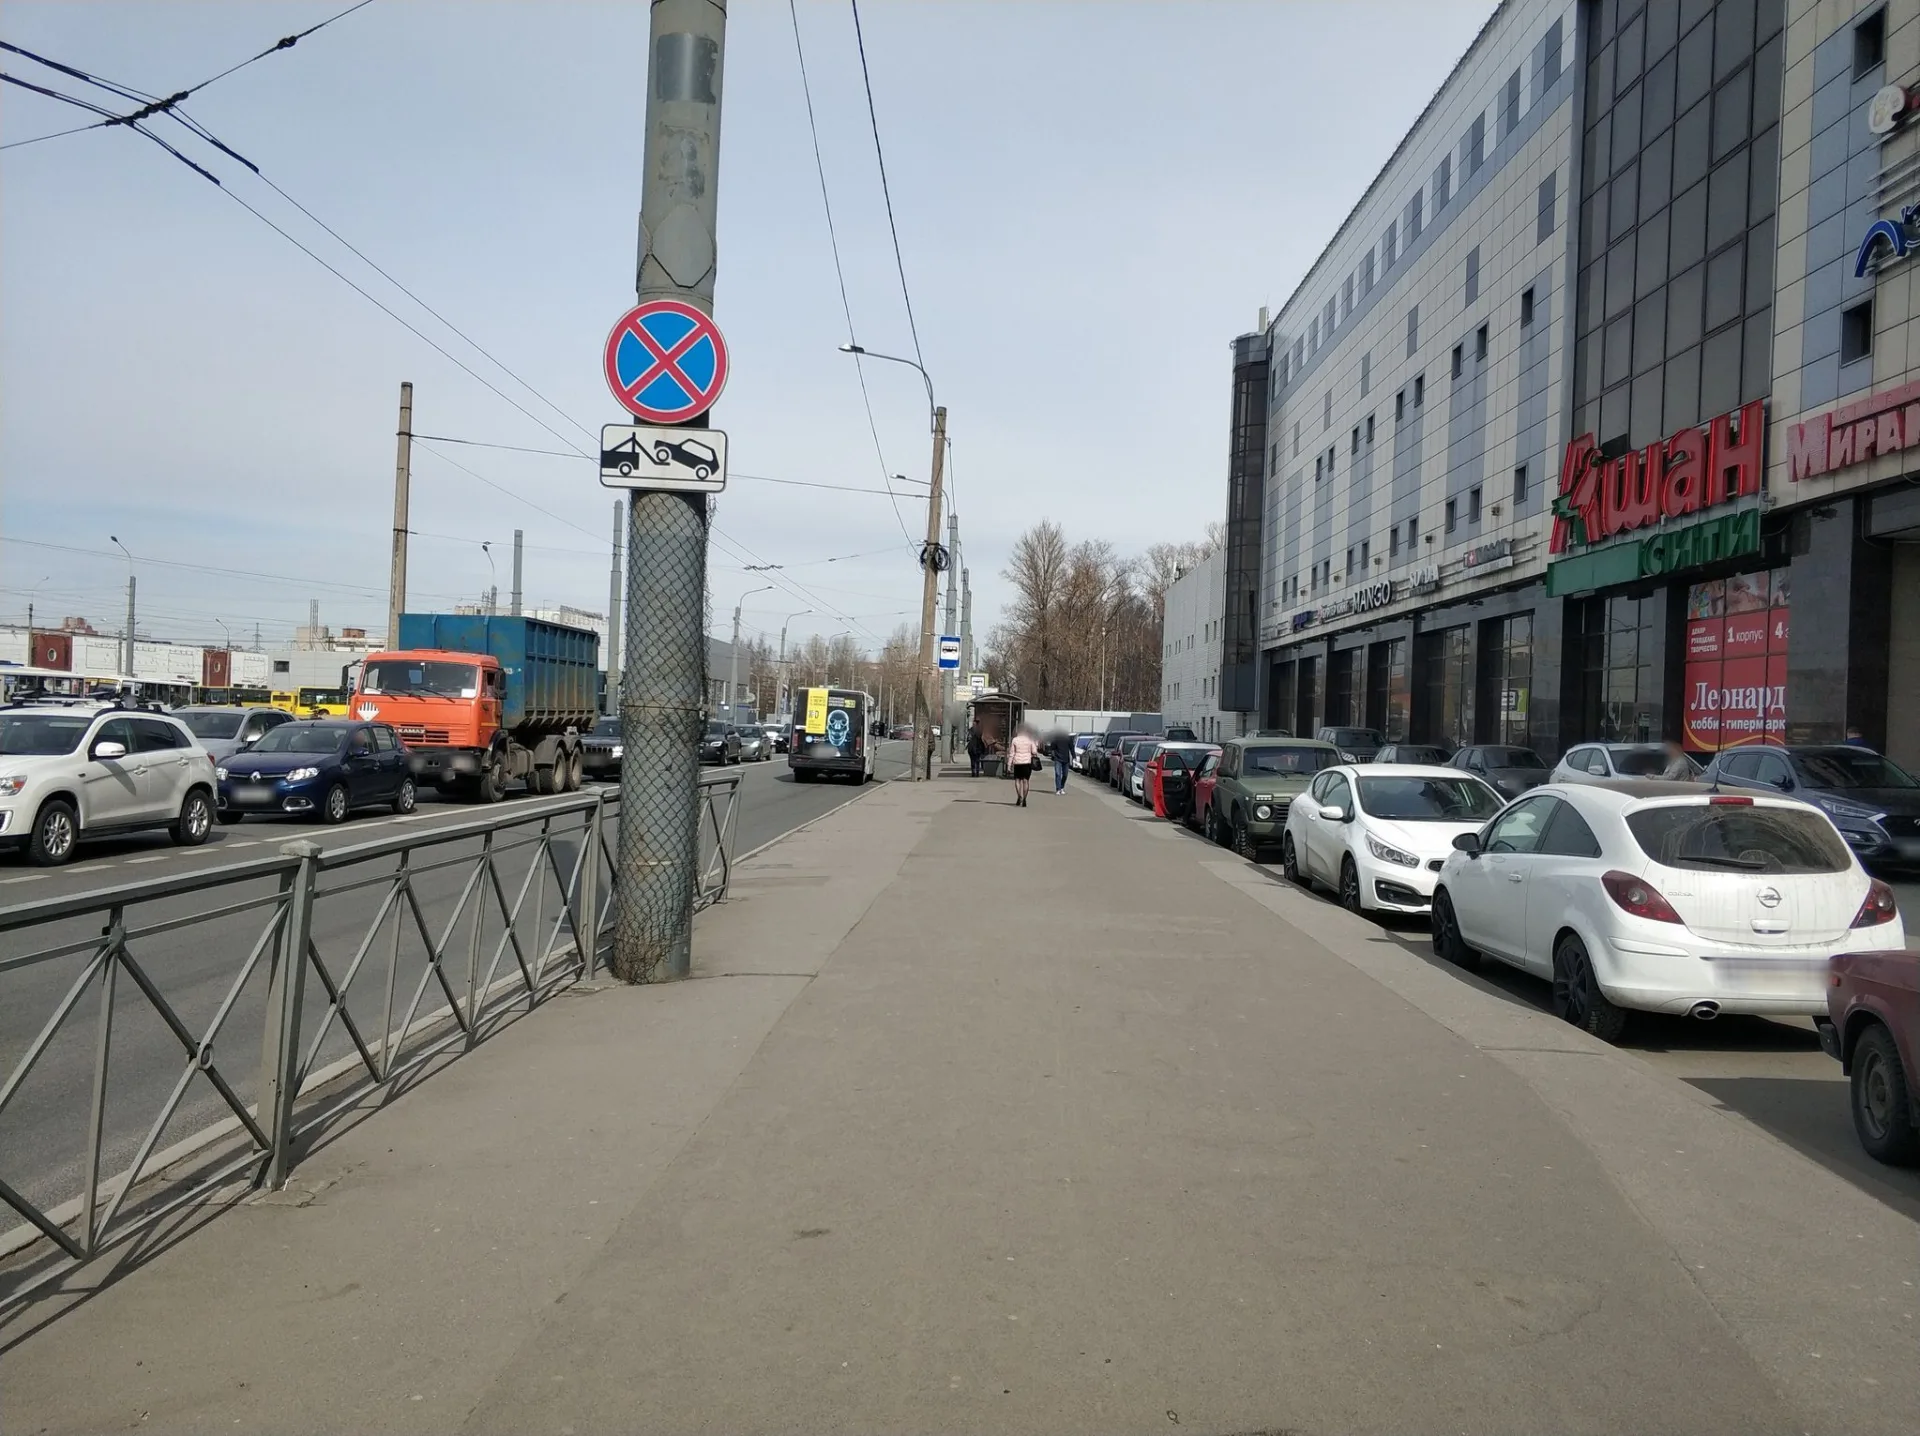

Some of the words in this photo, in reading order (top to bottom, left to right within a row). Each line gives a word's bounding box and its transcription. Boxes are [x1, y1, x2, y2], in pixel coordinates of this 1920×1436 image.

[1352, 579, 1392, 614] MANGO
[1727, 626, 1735, 643] 1
[1736, 630, 1764, 643] корпус
[1775, 622, 1784, 638] 4
